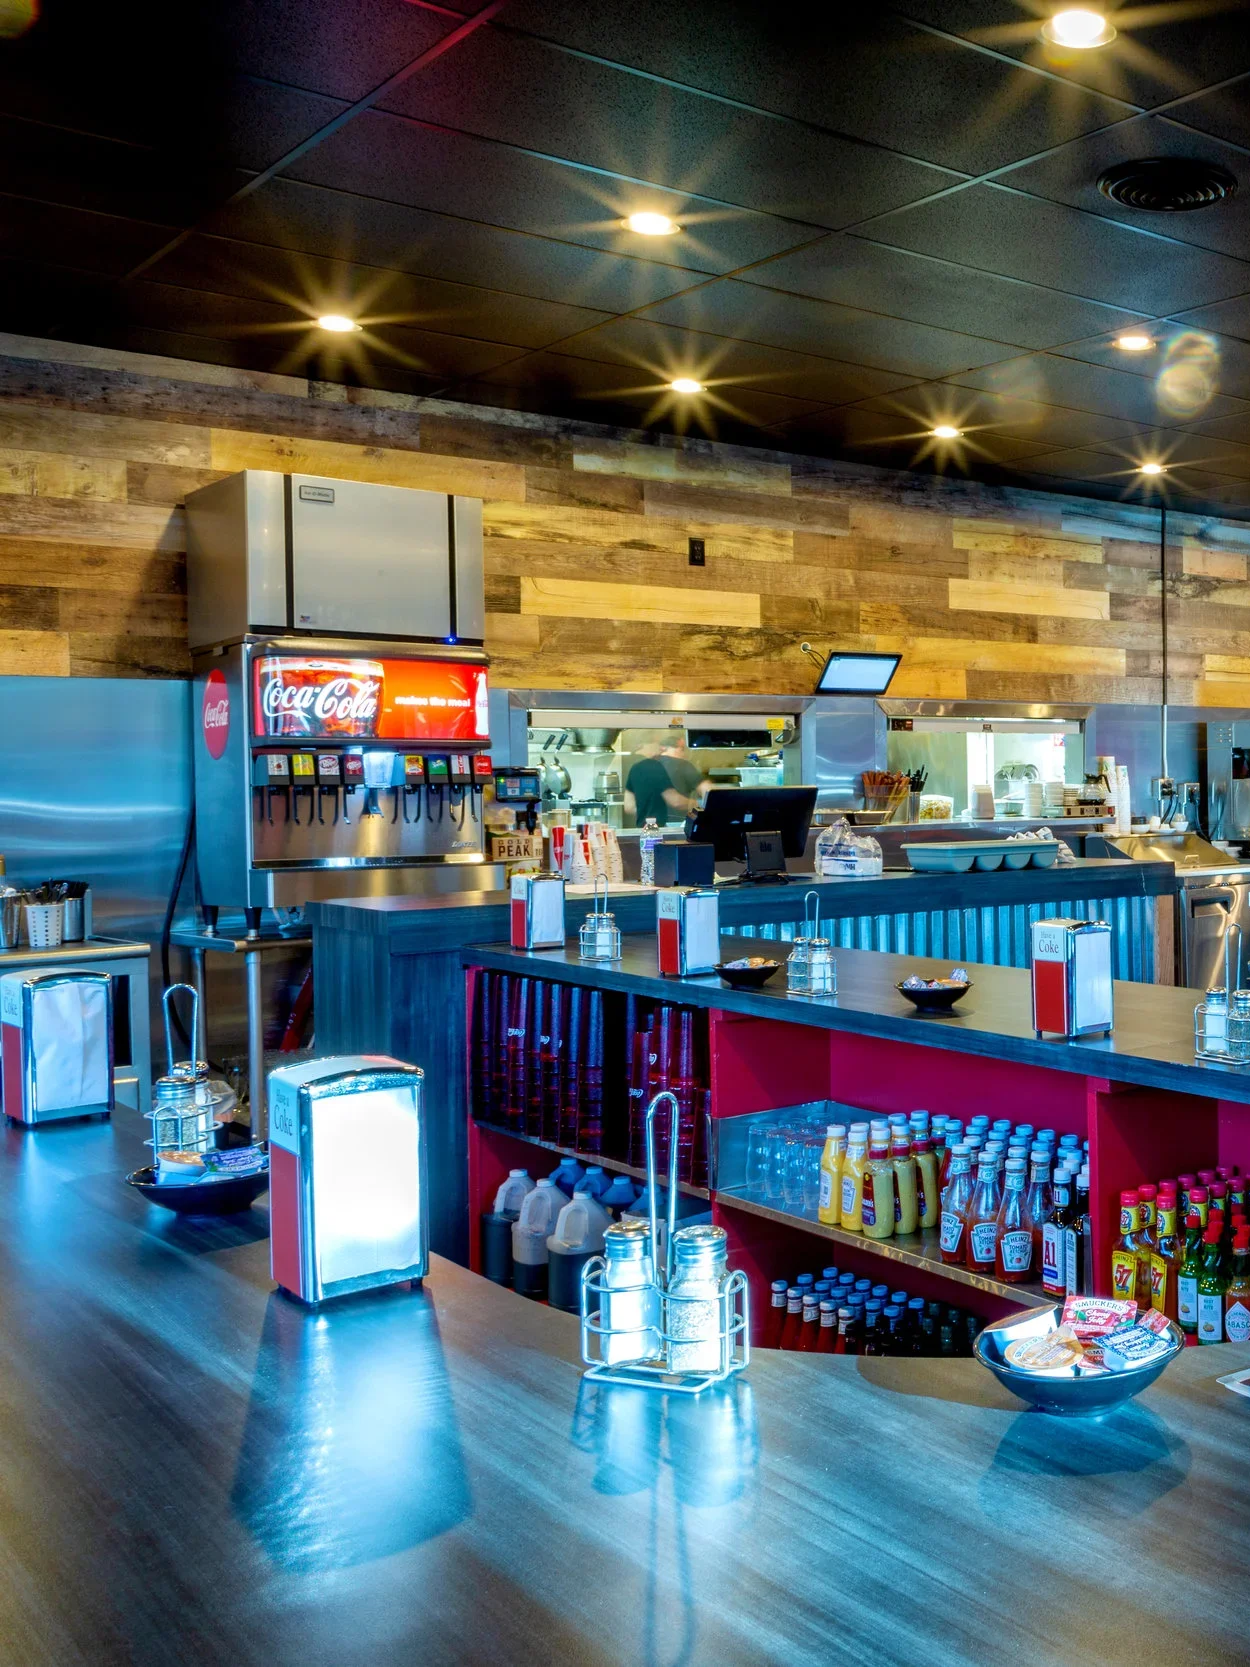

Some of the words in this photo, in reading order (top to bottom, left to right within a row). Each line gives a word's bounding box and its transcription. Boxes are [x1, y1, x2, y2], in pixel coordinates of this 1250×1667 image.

[263, 678, 380, 728] Coca-Cola
[429, 696, 446, 706] the
[447, 698, 470, 707] meal
[205, 699, 229, 728] Coca-Cola
[498, 845, 531, 857] PEAK
[1038, 939, 1059, 954] Coke
[274, 1104, 293, 1137] Coke
[1115, 1254, 1129, 1262] HEINZ
[1114, 1263, 1134, 1289] 57
